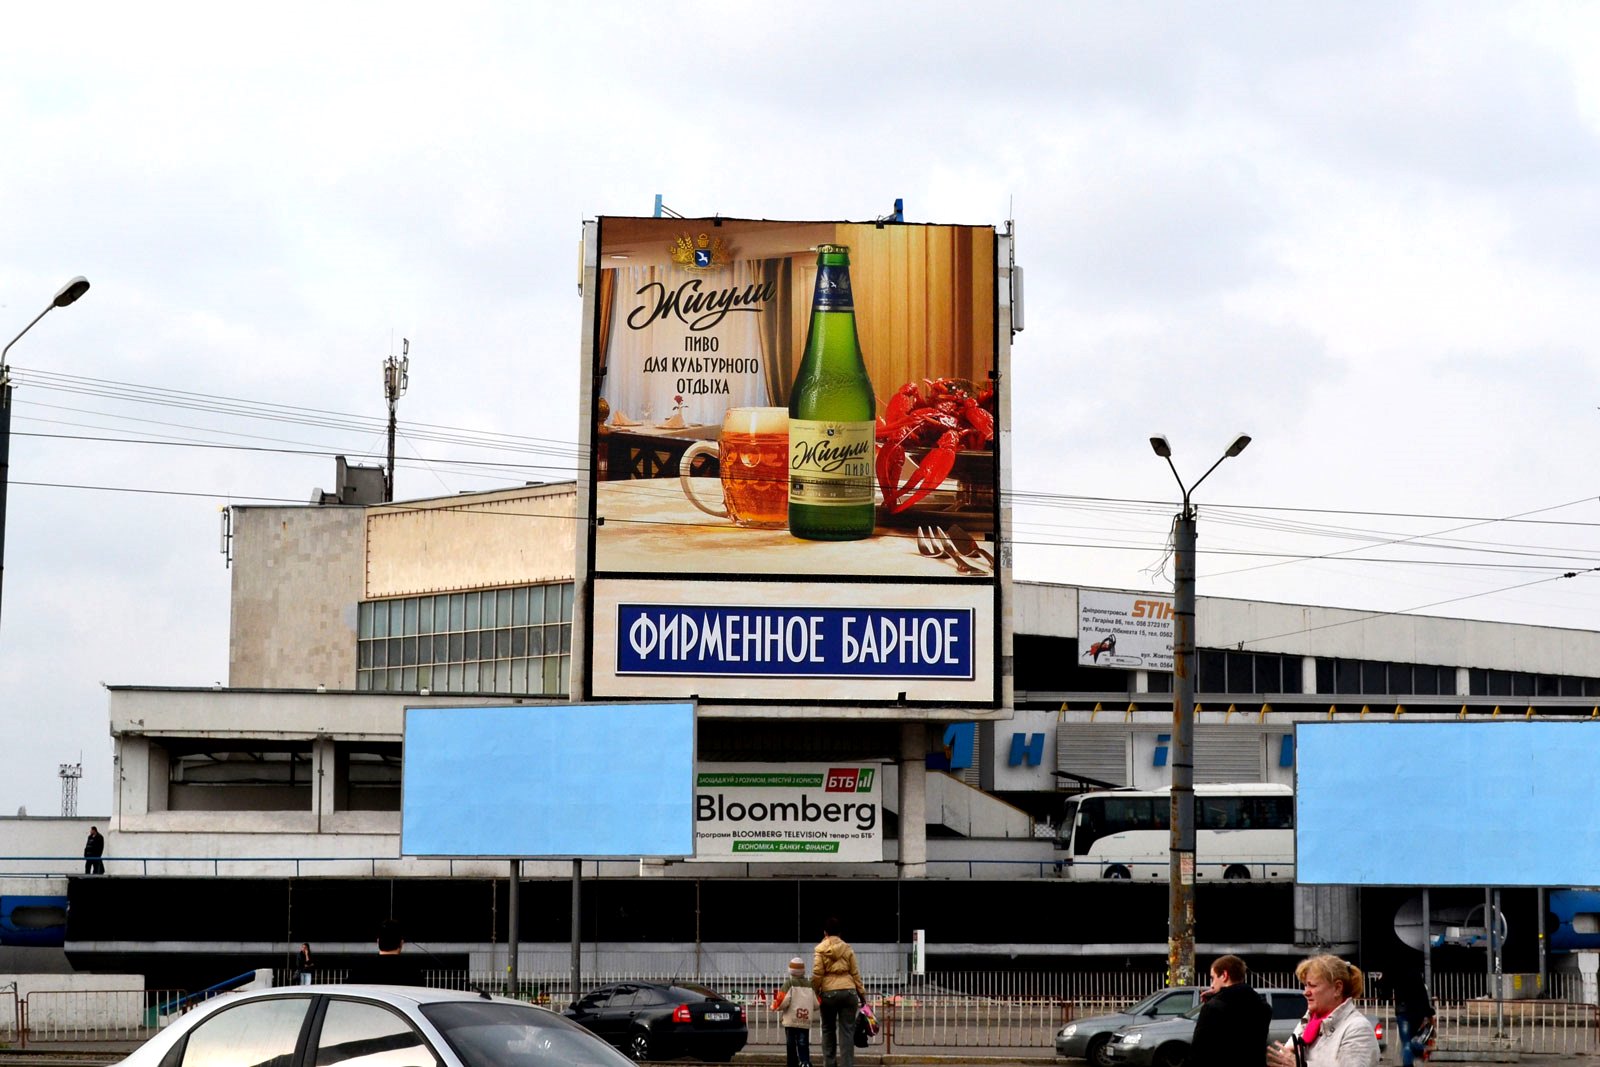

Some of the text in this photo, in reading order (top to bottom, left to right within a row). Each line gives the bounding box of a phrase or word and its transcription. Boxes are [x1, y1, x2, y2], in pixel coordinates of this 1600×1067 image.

[627, 279, 776, 331] Жигули
[684, 336, 720, 352] ПИВО
[643, 356, 759, 374] ДЛЯ КУЛЬТУРНОГО
[676, 378, 730, 395] ОТДЫХА
[791, 440, 869, 472] Жигули
[844, 463, 870, 477] ПИВО
[1082, 606, 1127, 616] Дніпропетровськ
[629, 612, 959, 664] ФИРМЕННОЕ БАРНОЕ
[828, 776, 854, 788] БТБ
[697, 794, 875, 830] Bloomberg
[732, 830, 782, 838] BLOOMBERG
[784, 831, 828, 839] TELEVISION
